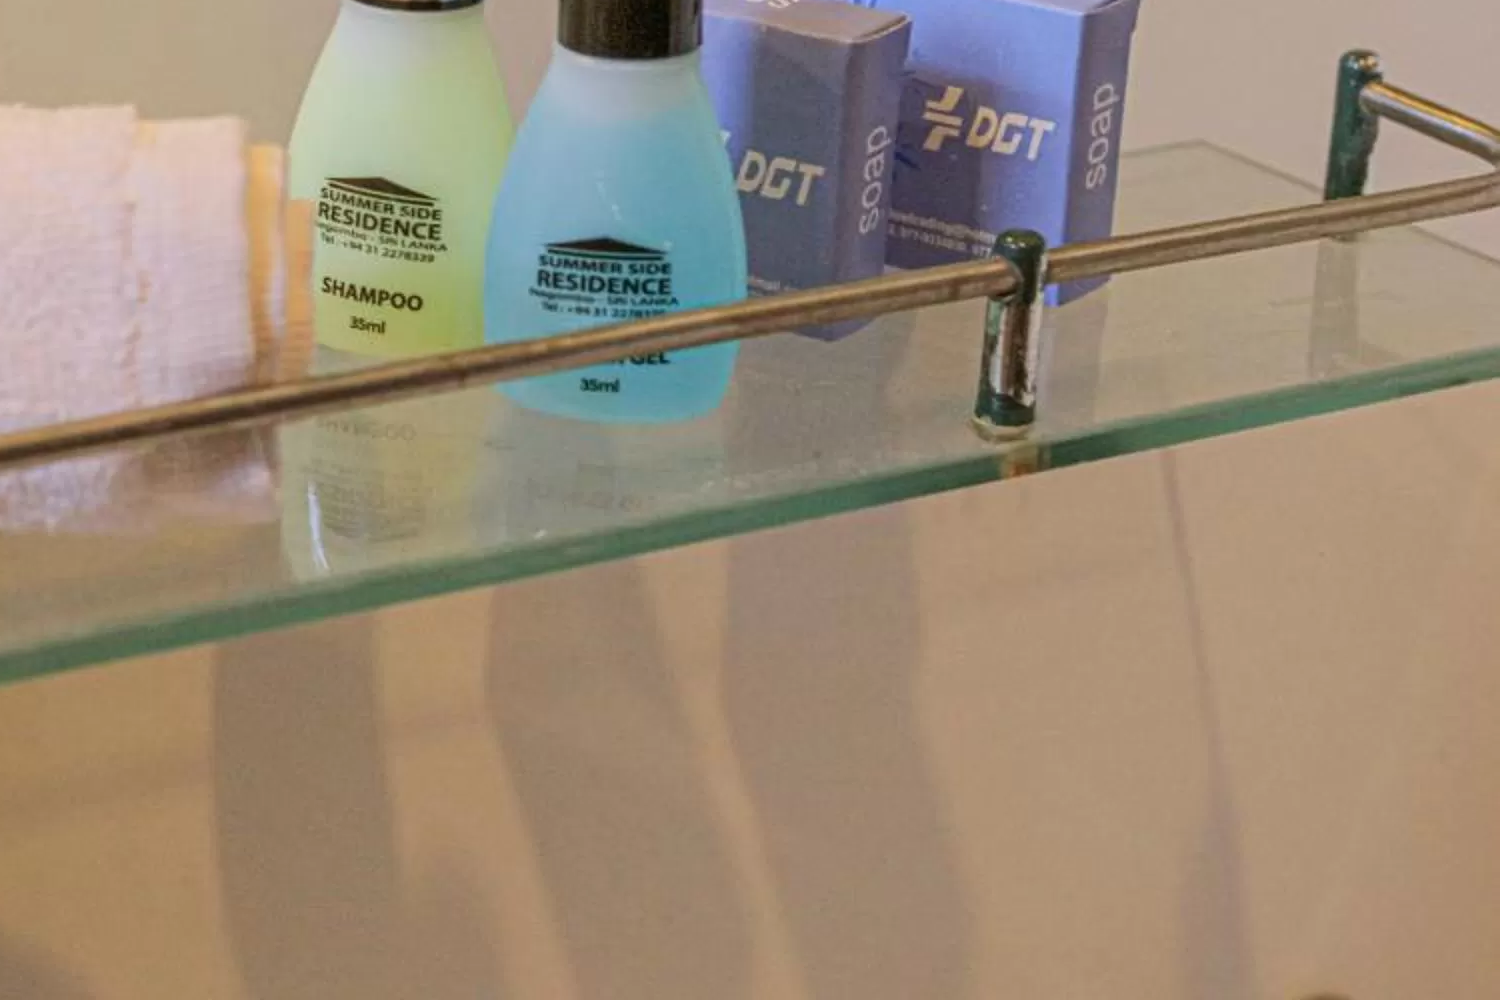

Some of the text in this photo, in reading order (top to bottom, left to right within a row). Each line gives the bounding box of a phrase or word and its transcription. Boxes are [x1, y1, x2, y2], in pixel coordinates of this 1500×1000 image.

[965, 105, 1057, 161] DGT
[1085, 83, 1120, 190] soap
[737, 149, 826, 206] DGT
[859, 125, 892, 235] soap
[320, 187, 443, 221] SUMMER SIDE
[318, 202, 442, 241] RESIDENCE
[401, 239, 448, 252] LANKA
[538, 254, 672, 275] SUMMER SIDE
[322, 276, 424, 312] SHAMPOO
[537, 269, 672, 296] RESIDENCE
[630, 297, 680, 306] LANKA
[349, 315, 387, 335] 35ml
[579, 377, 621, 393] 35ml
